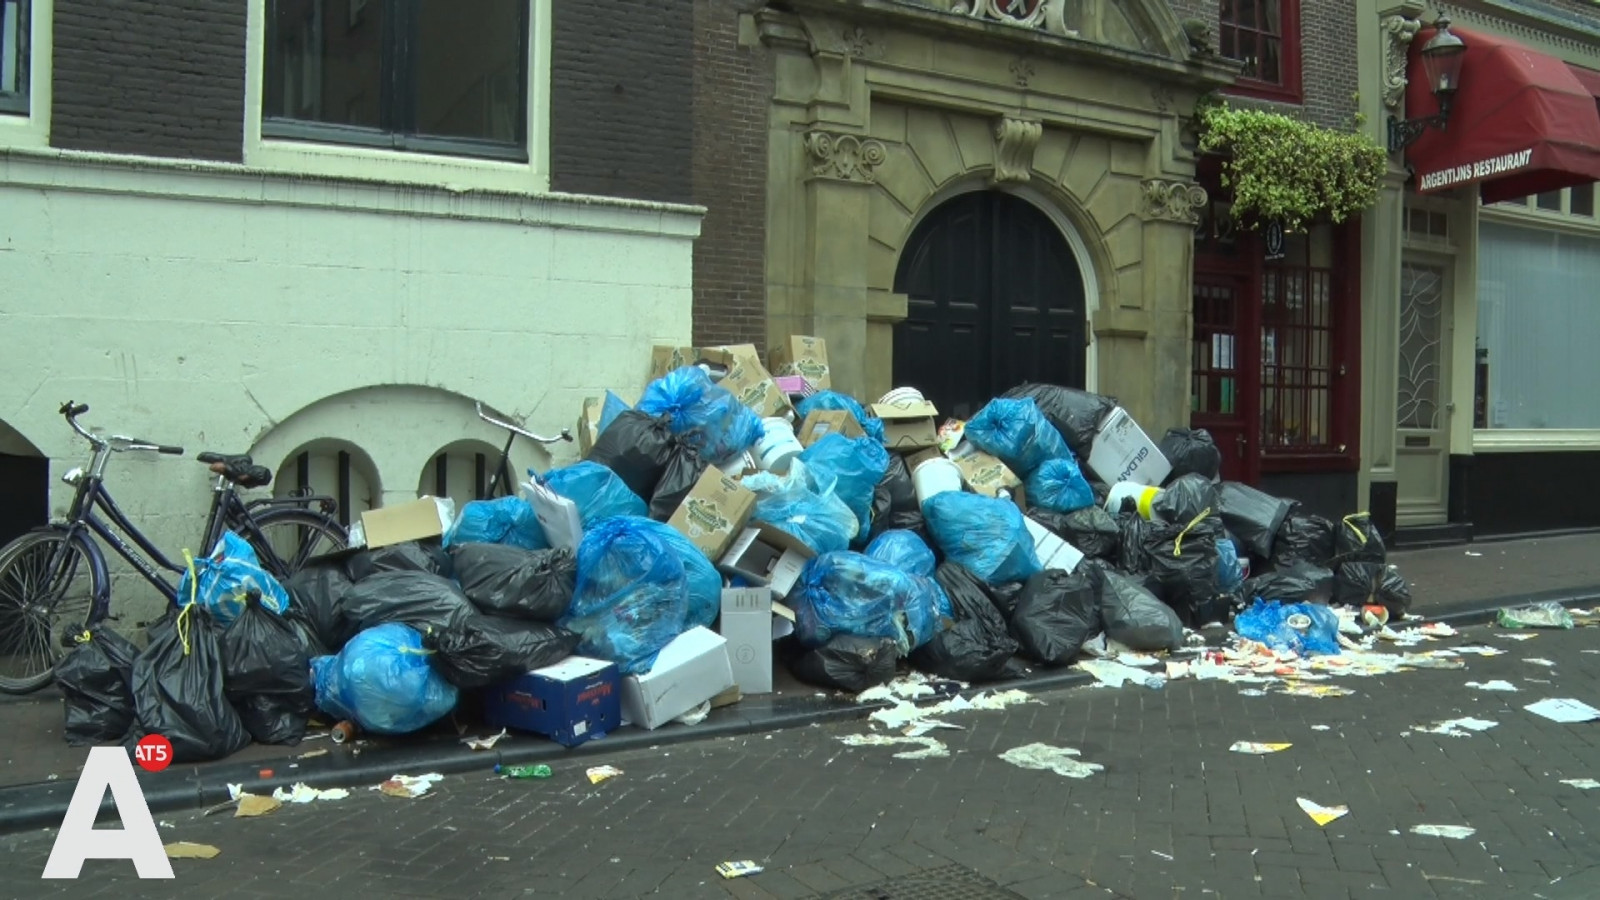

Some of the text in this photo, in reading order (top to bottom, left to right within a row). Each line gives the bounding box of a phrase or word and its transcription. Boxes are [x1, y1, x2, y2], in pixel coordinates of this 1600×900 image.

[1420, 148, 1532, 191] ARGENTIJNS RESTAURANT
[1117, 446, 1149, 482] GILDAN
